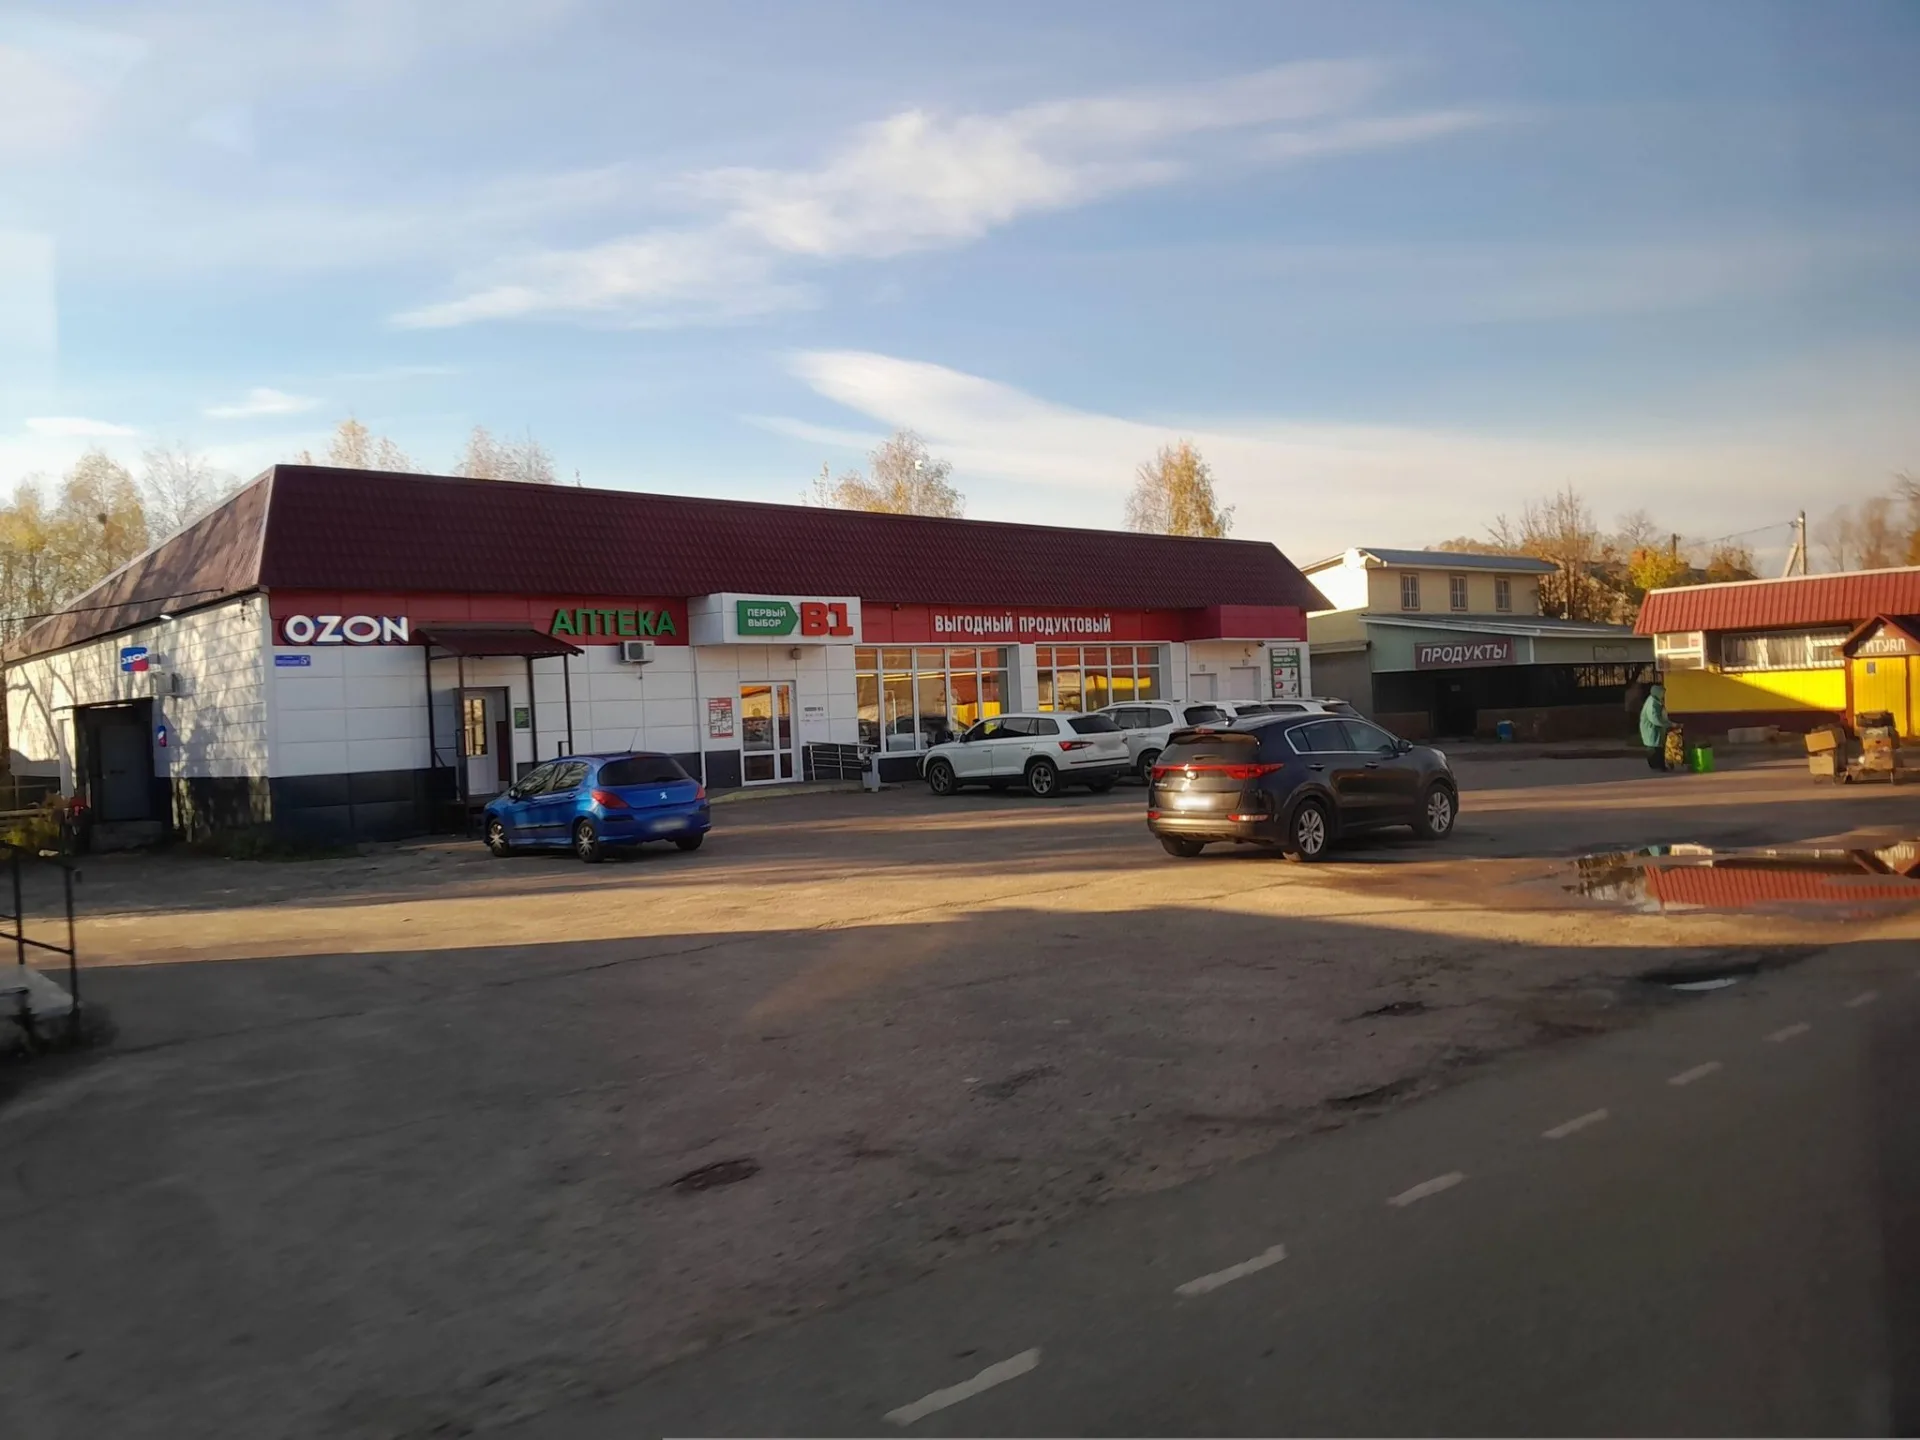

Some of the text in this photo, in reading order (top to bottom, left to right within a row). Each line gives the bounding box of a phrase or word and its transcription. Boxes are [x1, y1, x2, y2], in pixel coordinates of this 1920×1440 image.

[551, 608, 677, 636] АПТЕКА
[747, 606, 786, 617] ПЕРВЫЙ
[284, 614, 409, 643] OZON
[748, 619, 781, 628] ВЫБОР
[934, 611, 1111, 636] ВЫГОДНЫЙ ПРОДУКТОВЫЙ
[1421, 643, 1508, 664] ПРОДУКТЫ
